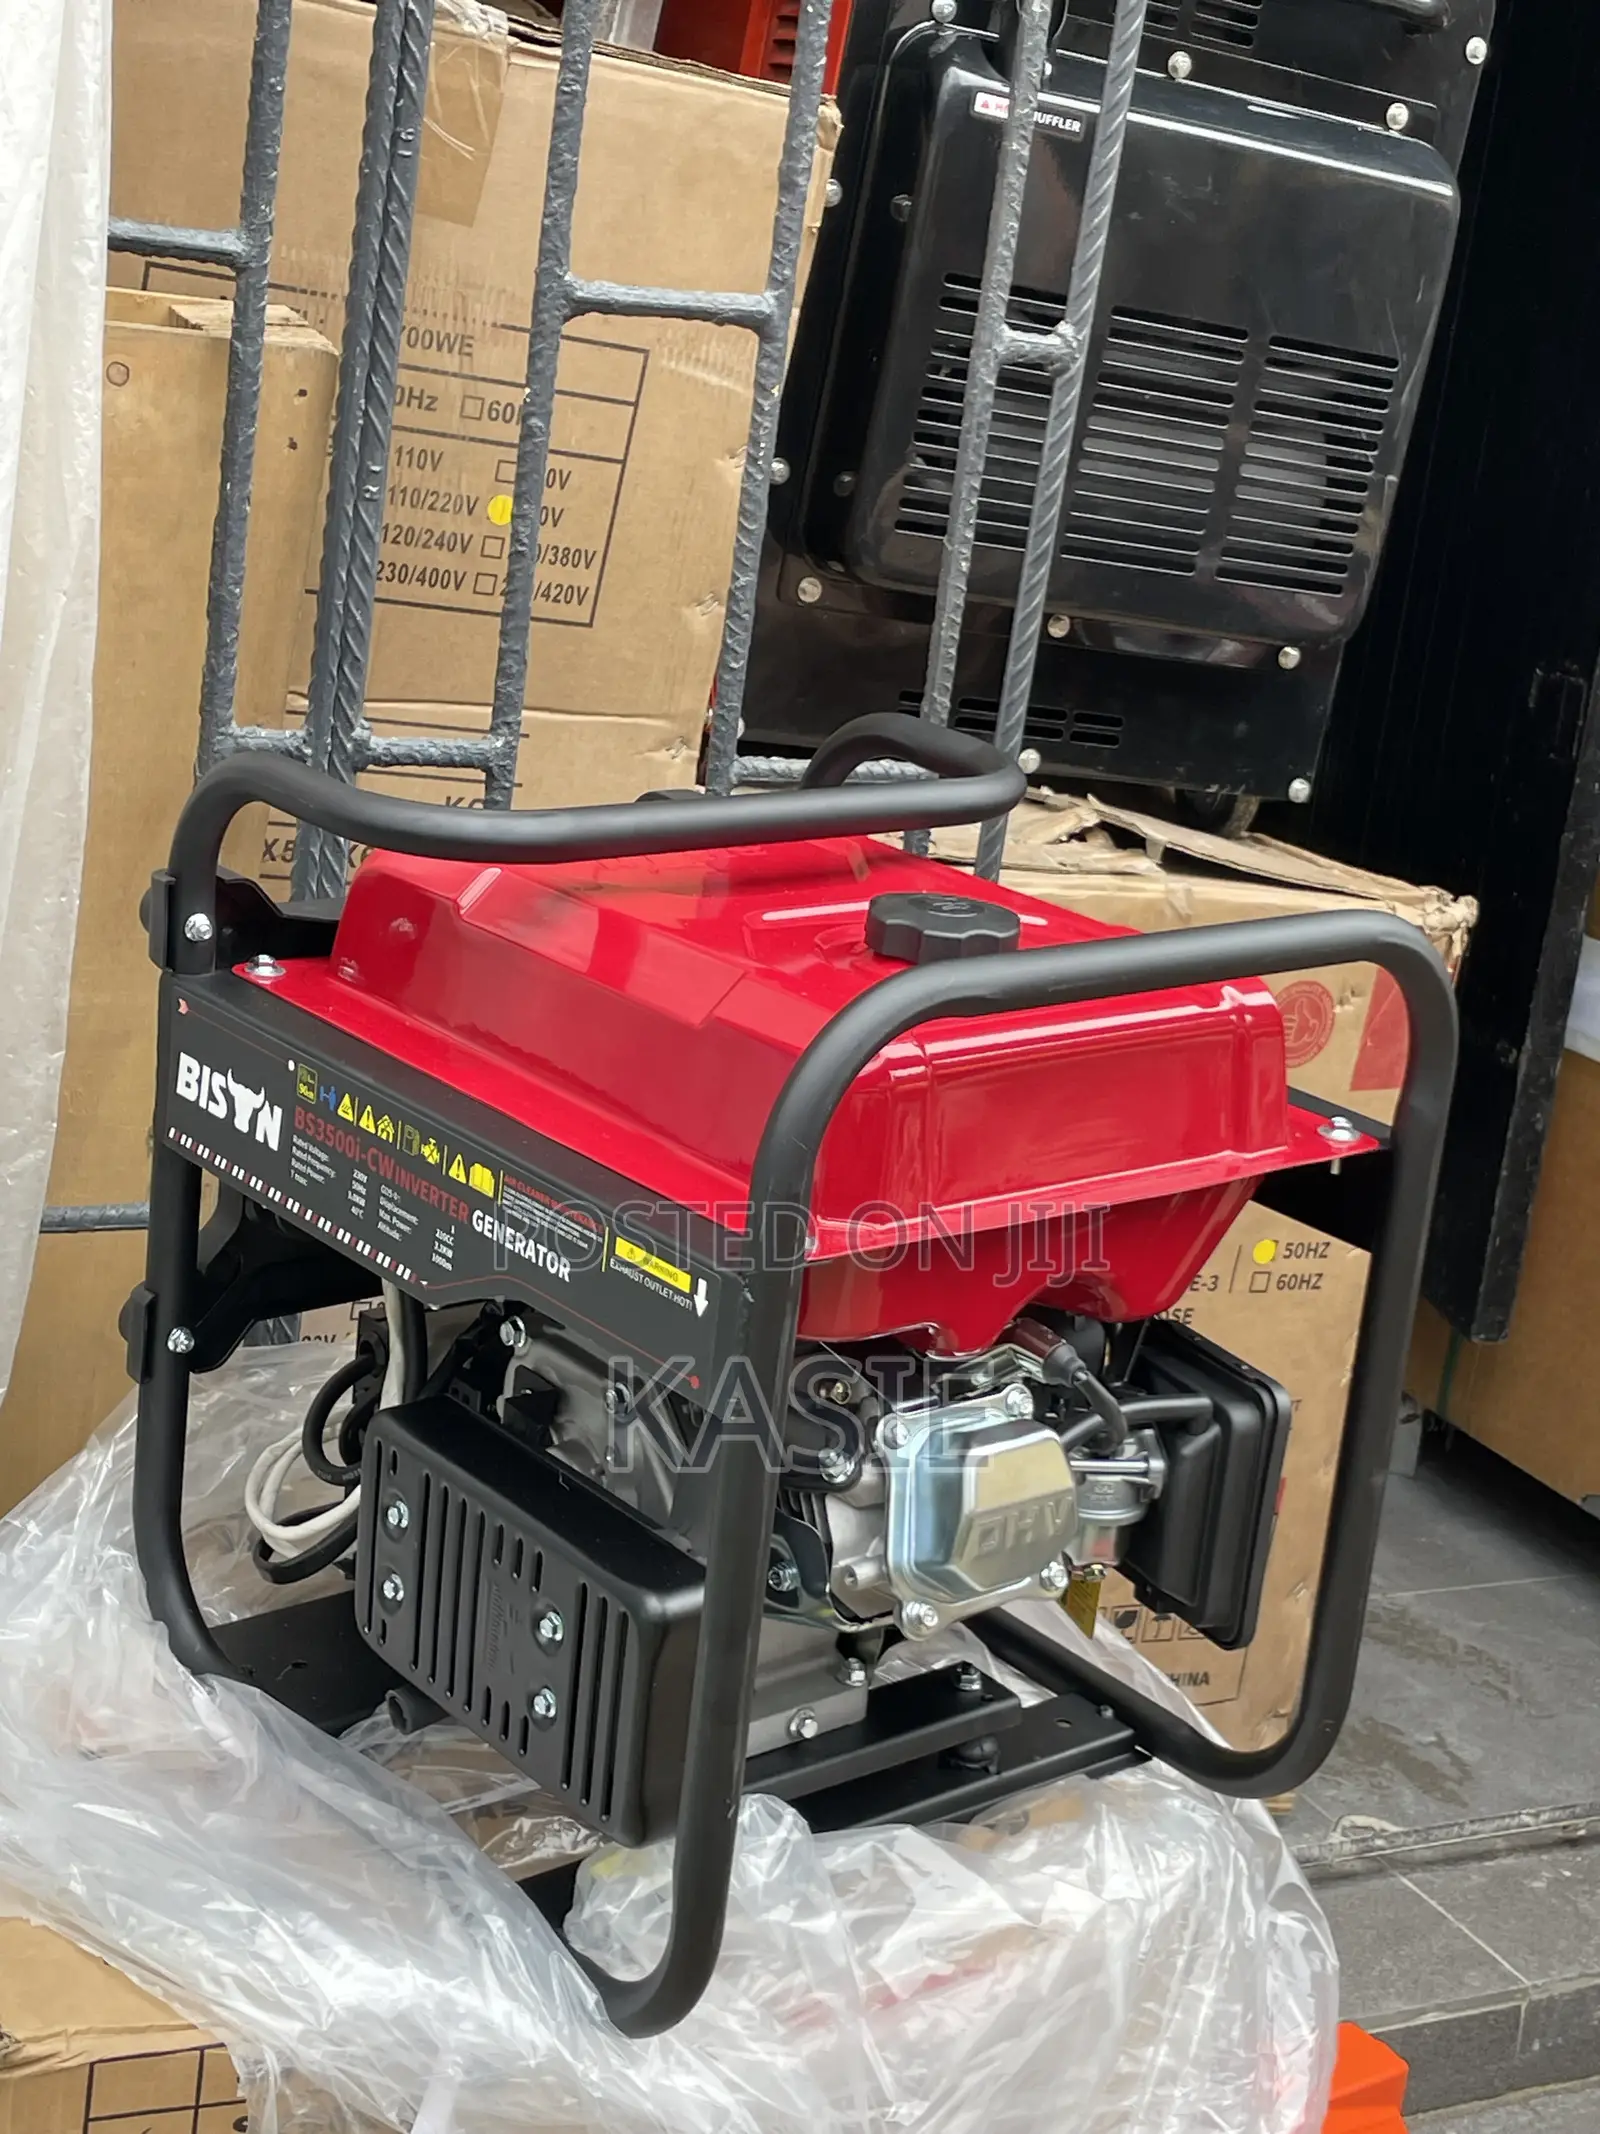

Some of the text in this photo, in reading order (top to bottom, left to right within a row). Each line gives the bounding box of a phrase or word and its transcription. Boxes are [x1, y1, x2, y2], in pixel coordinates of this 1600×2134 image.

[395, 384, 439, 412] 0Hz
[395, 445, 572, 491] 110V 0V
[388, 484, 565, 528] 110/220V 0V
[382, 522, 474, 554] 120/240V
[376, 560, 468, 592] 230/400V
[471, 1208, 571, 1282] GENERATOR
[1282, 1241, 1331, 1260] 50HZ
[609, 1257, 643, 1284] EXHAUST
[1189, 1273, 1324, 1292] E-3 60HZ
[1166, 1671, 1210, 1688] HINA
